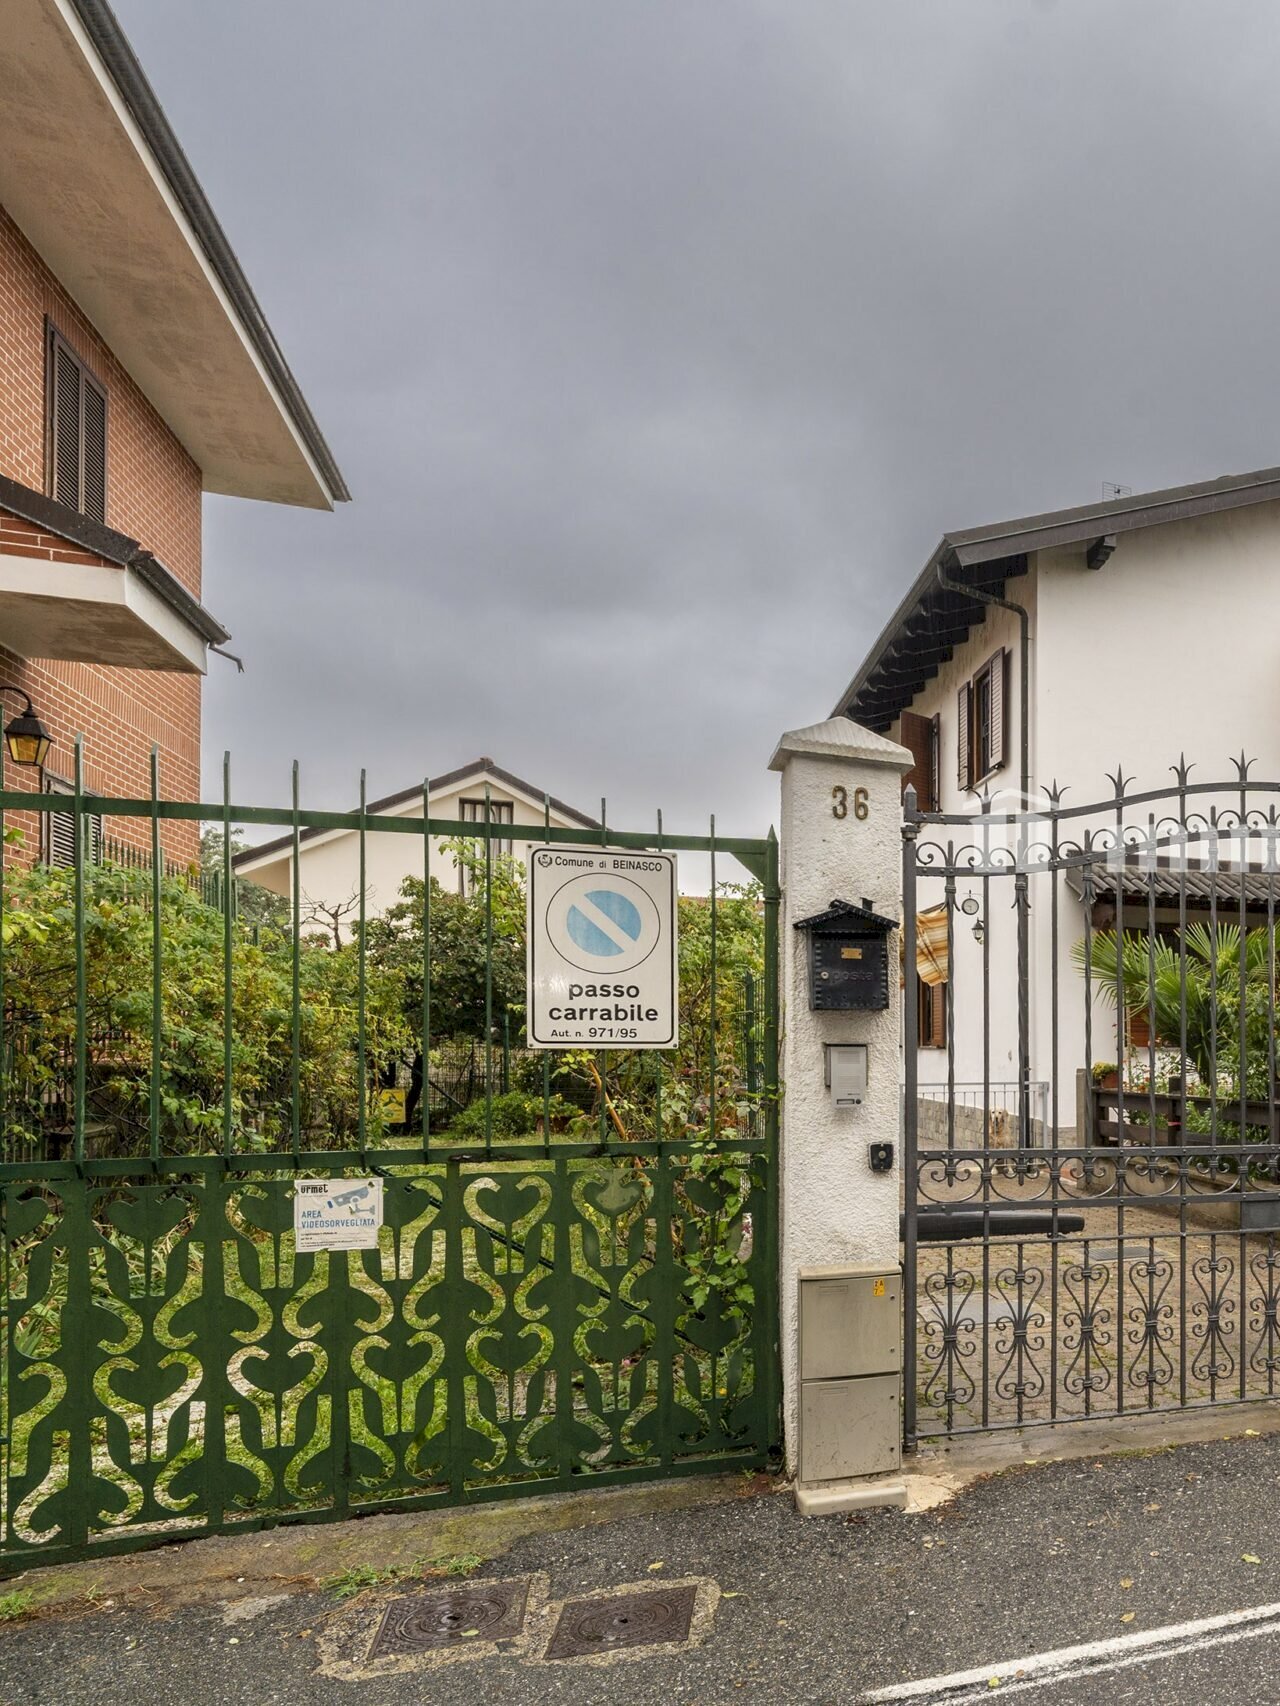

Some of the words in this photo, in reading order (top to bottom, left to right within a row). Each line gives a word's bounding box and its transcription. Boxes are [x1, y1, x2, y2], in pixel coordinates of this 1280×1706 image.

[831, 785, 869, 820] 36
[555, 856, 594, 868] Comune
[599, 860, 607, 869] di
[613, 859, 662, 872] BEINASCO
[568, 983, 640, 1001] passo
[548, 1004, 659, 1022] carrabile
[551, 1029, 572, 1038] Aut.
[588, 1027, 638, 1039] 971/95
[301, 1210, 322, 1218] AREA
[301, 1218, 376, 1229] VIDEOSORVEGLIATA
